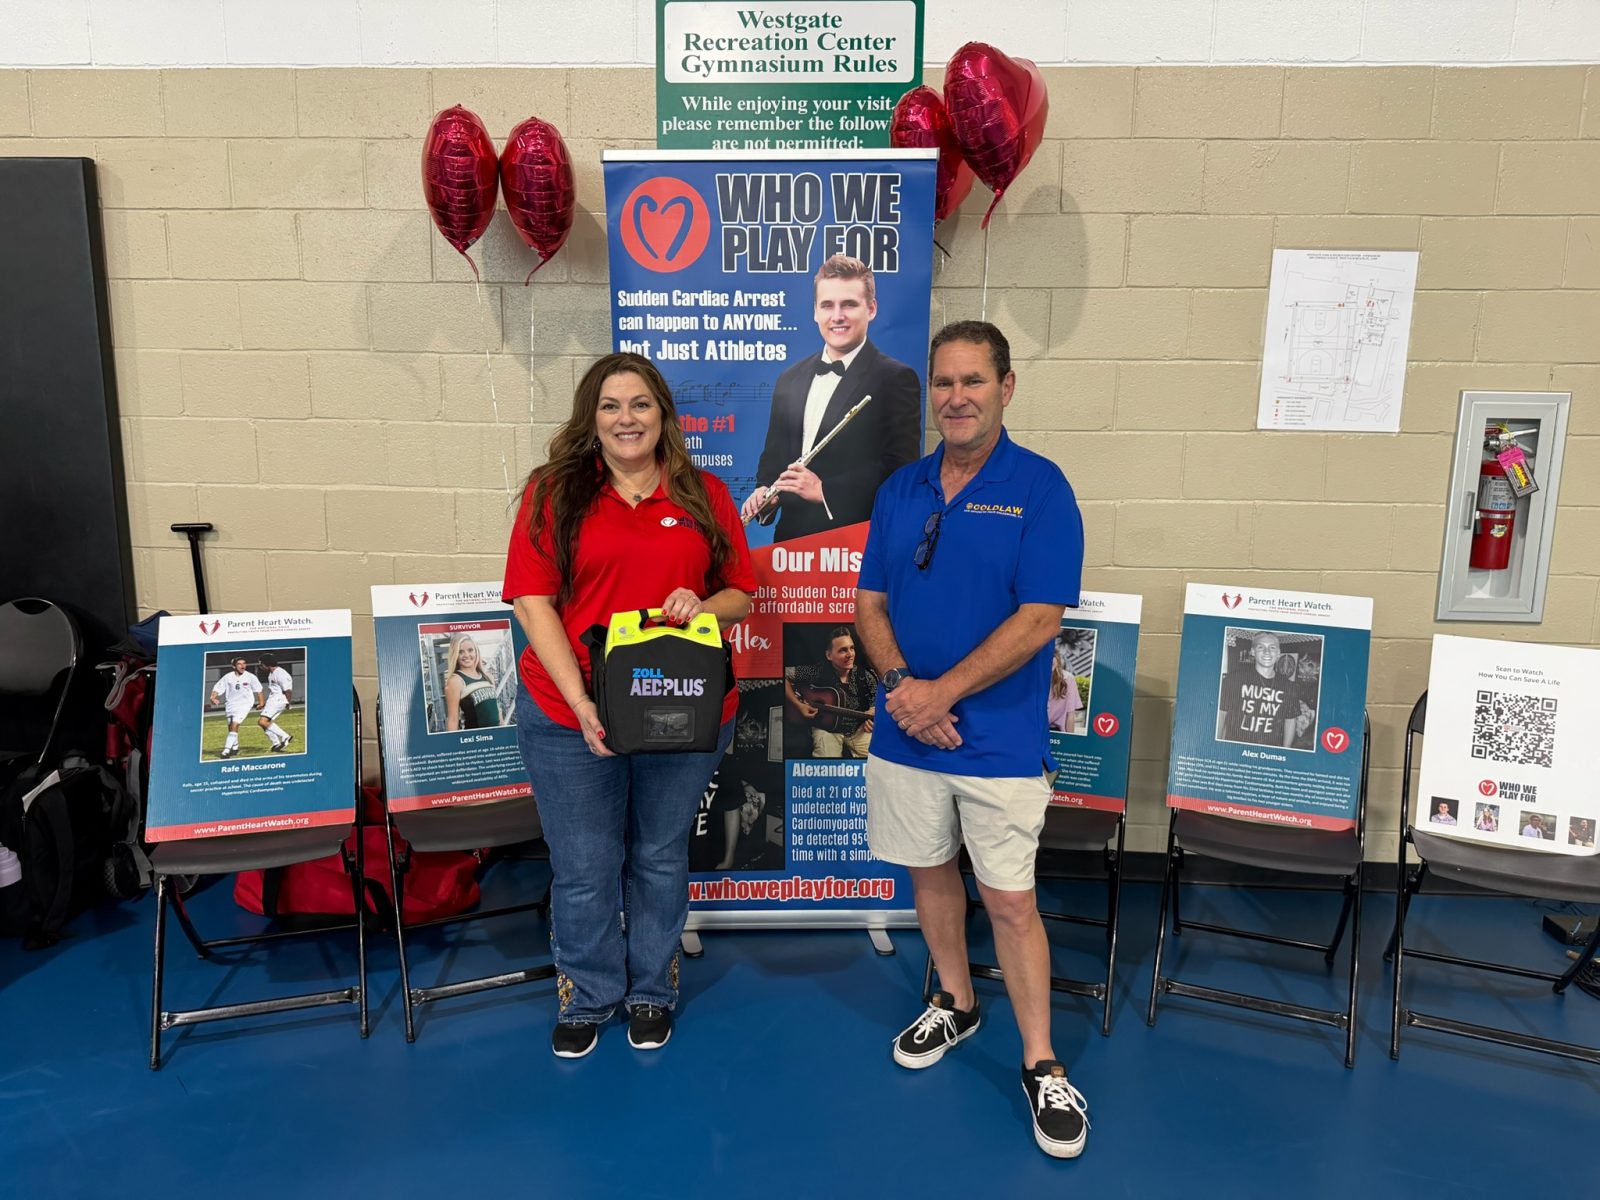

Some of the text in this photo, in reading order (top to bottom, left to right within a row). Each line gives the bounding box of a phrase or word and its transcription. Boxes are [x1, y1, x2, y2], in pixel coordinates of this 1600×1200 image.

[737, 10, 842, 33] Westgate
[684, 32, 896, 51] Recreation Center
[681, 54, 897, 77] Gymnasium Rules
[681, 96, 732, 111] While
[737, 96, 808, 114] enjoying
[812, 99, 851, 114] your
[662, 115, 891, 134] please remember the follow
[712, 136, 863, 149] are not permitted:
[716, 173, 901, 225] WHO WE
[722, 225, 898, 273] PLAY FOR
[618, 290, 786, 307] Sudden Cardiac Arrest
[619, 314, 798, 332] can happen to ANYONE...
[619, 340, 787, 361] Not Just Athletes
[712, 415, 735, 433] #1
[684, 436, 703, 450] ath
[691, 454, 733, 468] mpuses
[772, 547, 862, 572] Our Mis
[435, 592, 460, 600] Parent
[462, 591, 484, 599] Heart
[782, 586, 827, 599] Sudden
[760, 601, 824, 614] affordable
[829, 602, 855, 614] scre
[1248, 596, 1275, 606] Parent
[1277, 599, 1301, 608] Heart
[227, 620, 255, 628] Parent
[257, 618, 281, 627] Heart
[449, 623, 481, 631] SURVIVOR
[729, 623, 772, 654] Alex
[632, 668, 665, 679] ZOLL
[1478, 671, 1494, 679] How
[1523, 676, 1540, 684] Save
[1521, 668, 1544, 676] Watch
[1241, 684, 1284, 703] MUSIC
[1241, 699, 1280, 716] IS MY
[1240, 714, 1273, 733] LIFE
[460, 736, 474, 744] Lexi
[1242, 749, 1287, 762] Alex Dumas
[242, 763, 286, 772] Maccarone
[792, 762, 859, 777] Alexander
[792, 786, 867, 799] Died at 21 of SC
[1499, 781, 1537, 794] WHO WE
[431, 786, 532, 805] www.ParentHeartWatch.org
[1499, 790, 1536, 803] PLAY FOR
[792, 802, 867, 816] undetected Hyp
[1207, 804, 1312, 826] www.ParentHeartWatch.org
[193, 817, 309, 835] www.ParentHeartWatch.org
[792, 832, 803, 846] be
[806, 833, 849, 846] detected
[792, 848, 875, 863] time with a simp
